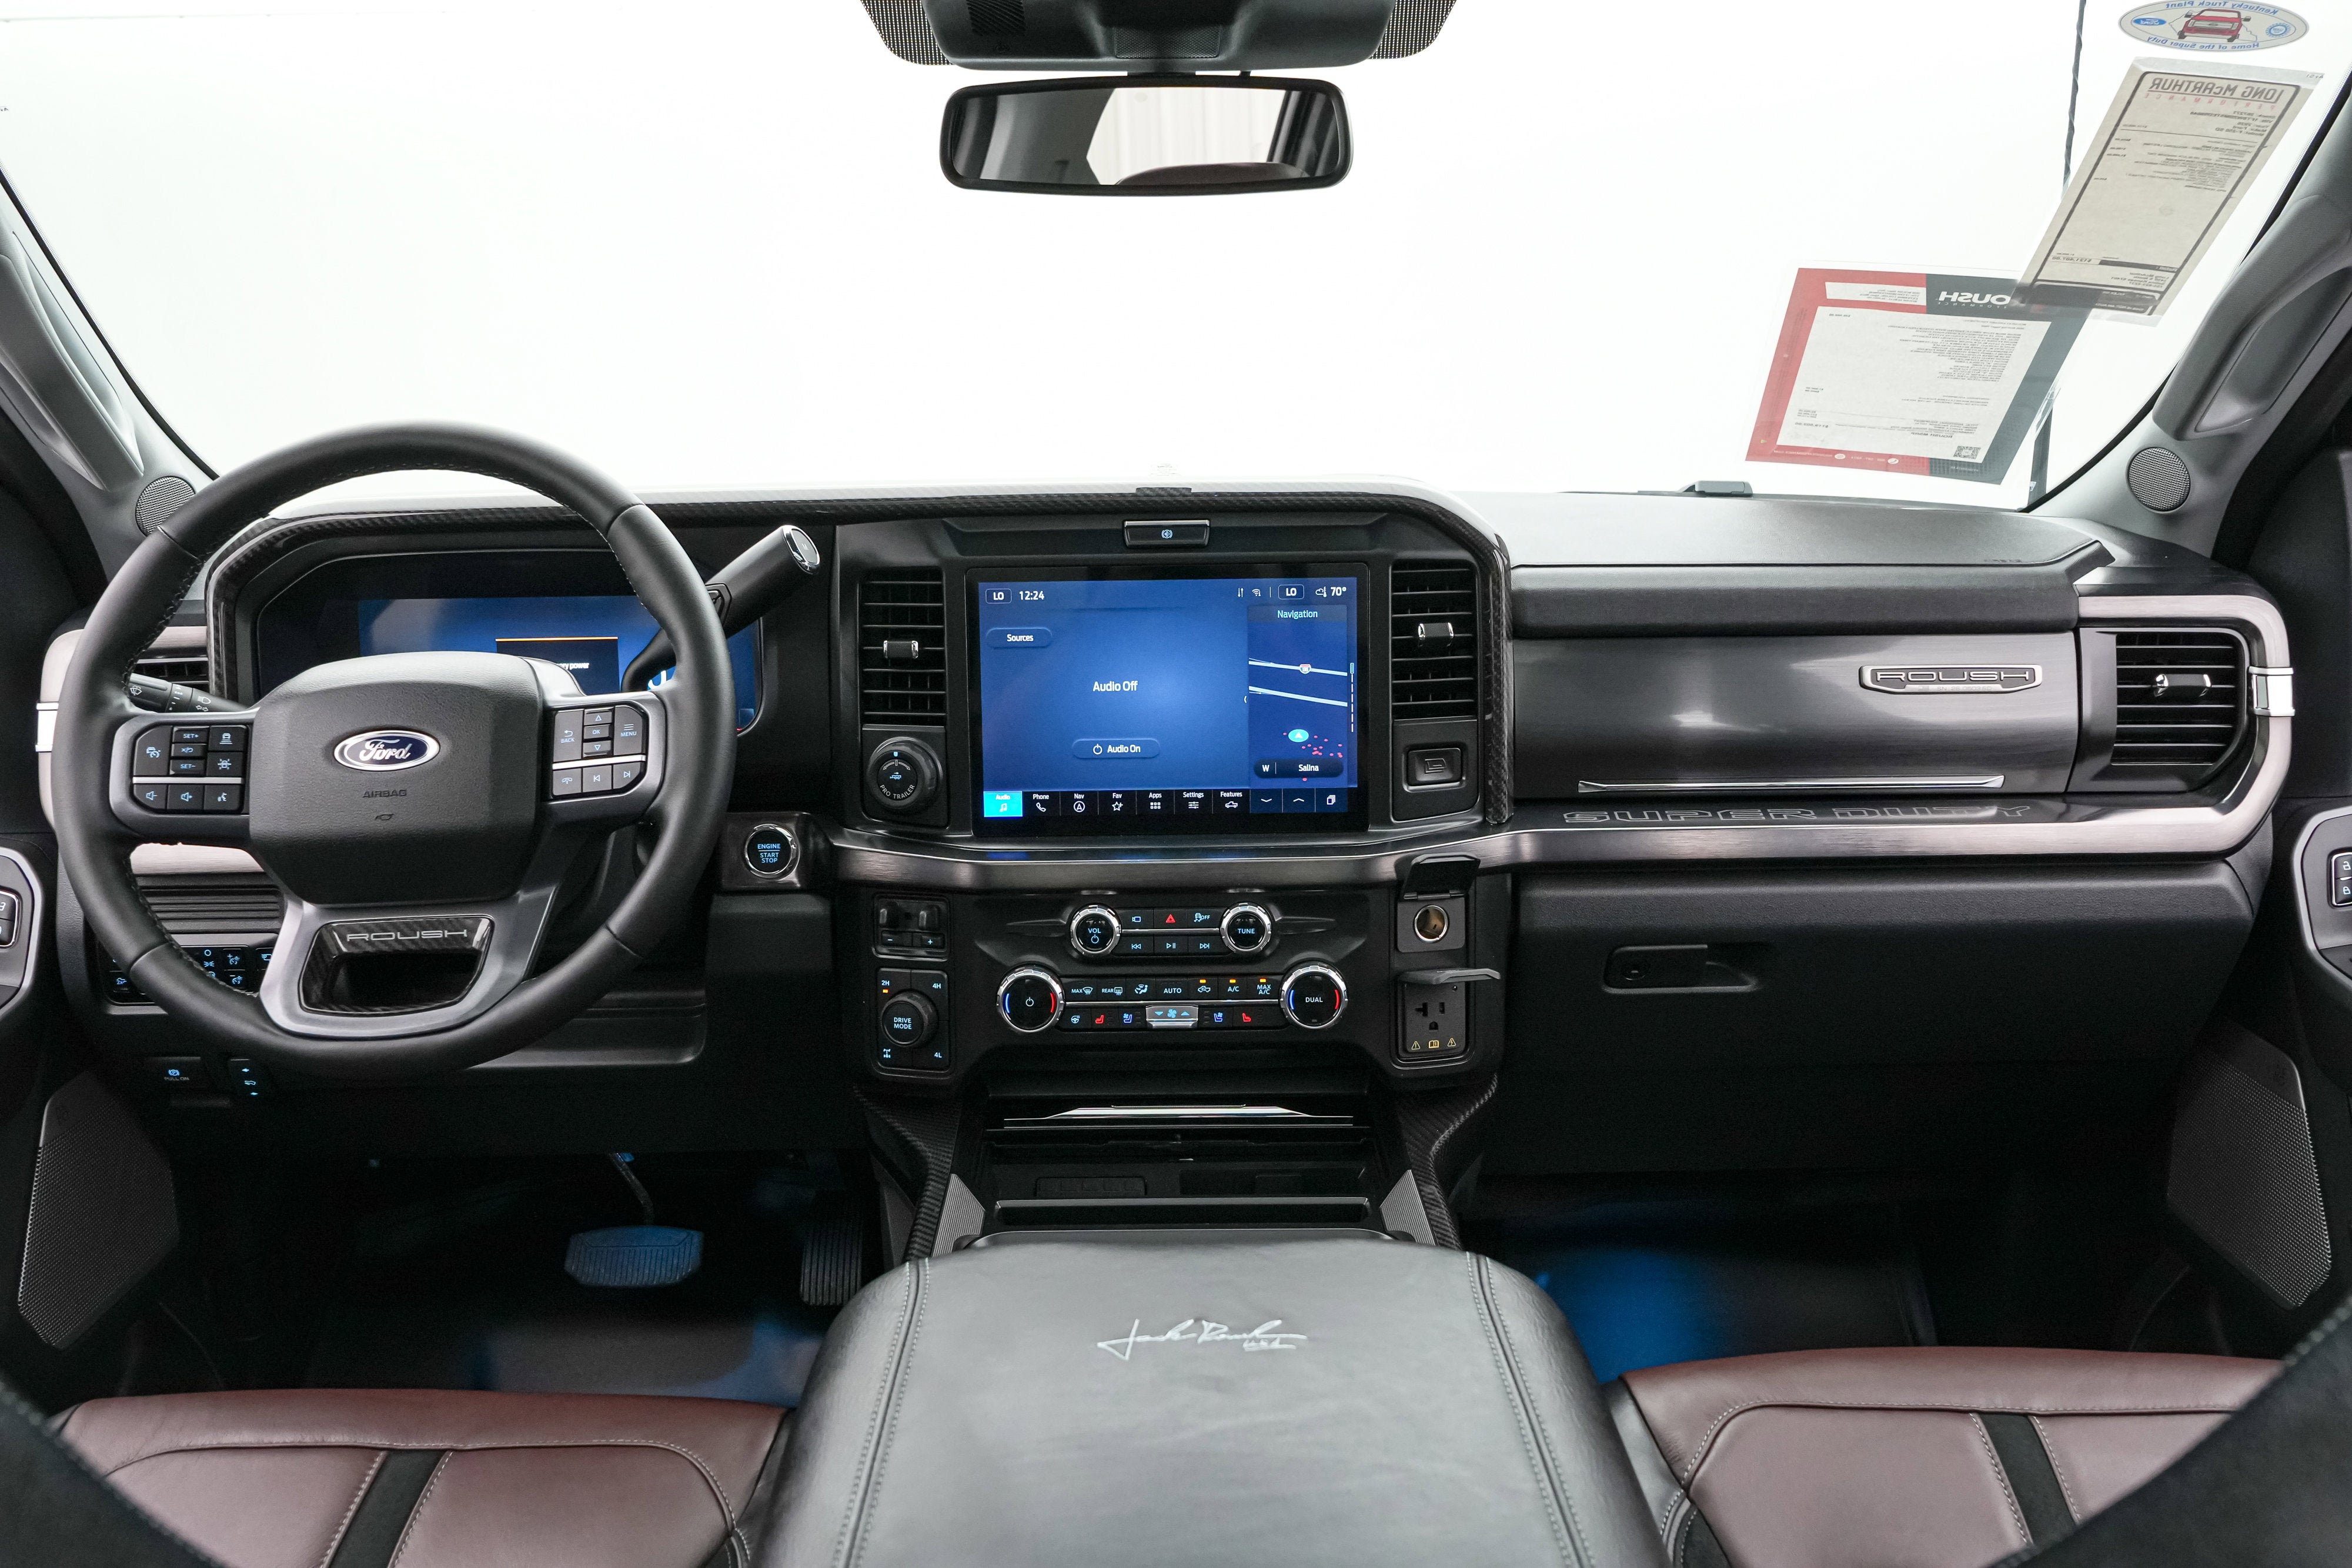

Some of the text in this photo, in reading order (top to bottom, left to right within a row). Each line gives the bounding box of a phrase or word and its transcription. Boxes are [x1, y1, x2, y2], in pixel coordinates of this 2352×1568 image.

[993, 591, 1004, 600] LO
[1019, 590, 1045, 600] 12:24
[1285, 587, 1297, 596] LO
[1277, 610, 1318, 619] Navigation
[1007, 634, 1034, 642] Sources
[1875, 671, 2029, 682] ROUSH
[1093, 680, 1138, 692] Audio Off
[359, 738, 413, 761] Ford
[1107, 744, 1141, 753] Audio On
[1298, 764, 1319, 772] Salina
[362, 789, 407, 798] AIRBAG
[880, 784, 916, 799] PRO TRAILER
[1563, 805, 2030, 823] SUPER DUTY
[346, 929, 468, 942] ROUSH
